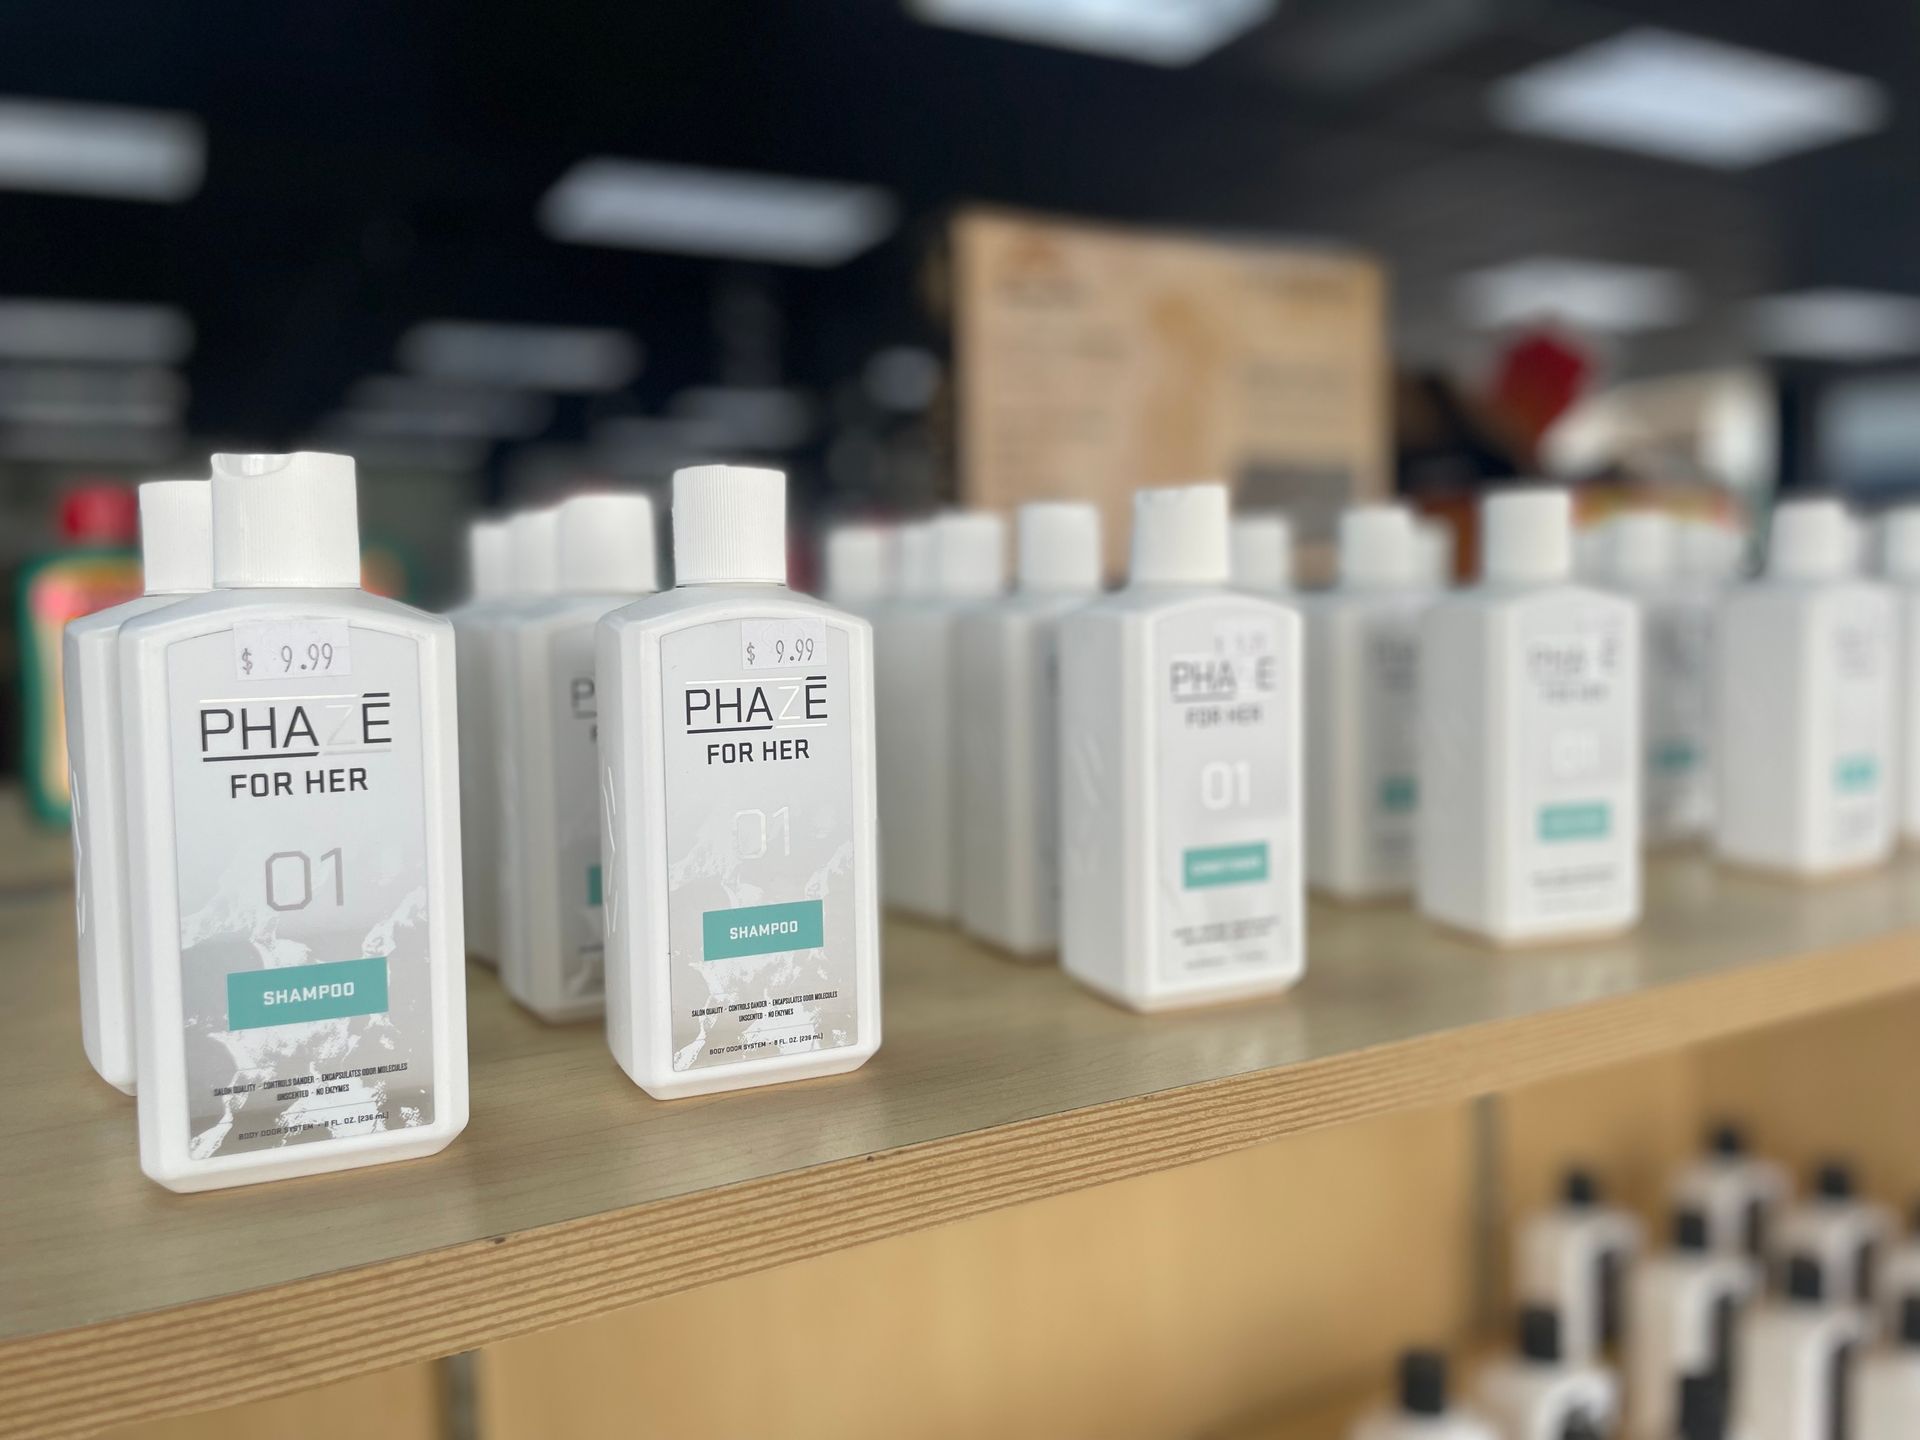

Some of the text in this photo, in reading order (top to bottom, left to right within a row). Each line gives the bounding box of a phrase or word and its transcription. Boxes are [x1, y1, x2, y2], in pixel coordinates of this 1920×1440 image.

[281, 643, 333, 673] 9.99
[776, 638, 814, 664] 9.99
[685, 676, 828, 726] PHAZE
[200, 693, 393, 753] PHAZE
[707, 739, 810, 765] FOR HER
[231, 767, 369, 799] FOR HER
[1202, 760, 1250, 810] 01
[735, 806, 790, 860] 01
[265, 847, 344, 912] 01
[729, 920, 799, 940] SHAMPOO
[263, 982, 355, 1006] SHAMPOO
[709, 1047, 726, 1056] BODY
[321, 1069, 361, 1082] ENCAPSULATES
[377, 1062, 408, 1074] MOLECULES
[238, 1131, 259, 1141] BODY
[283, 1123, 314, 1134] SYSTEM
